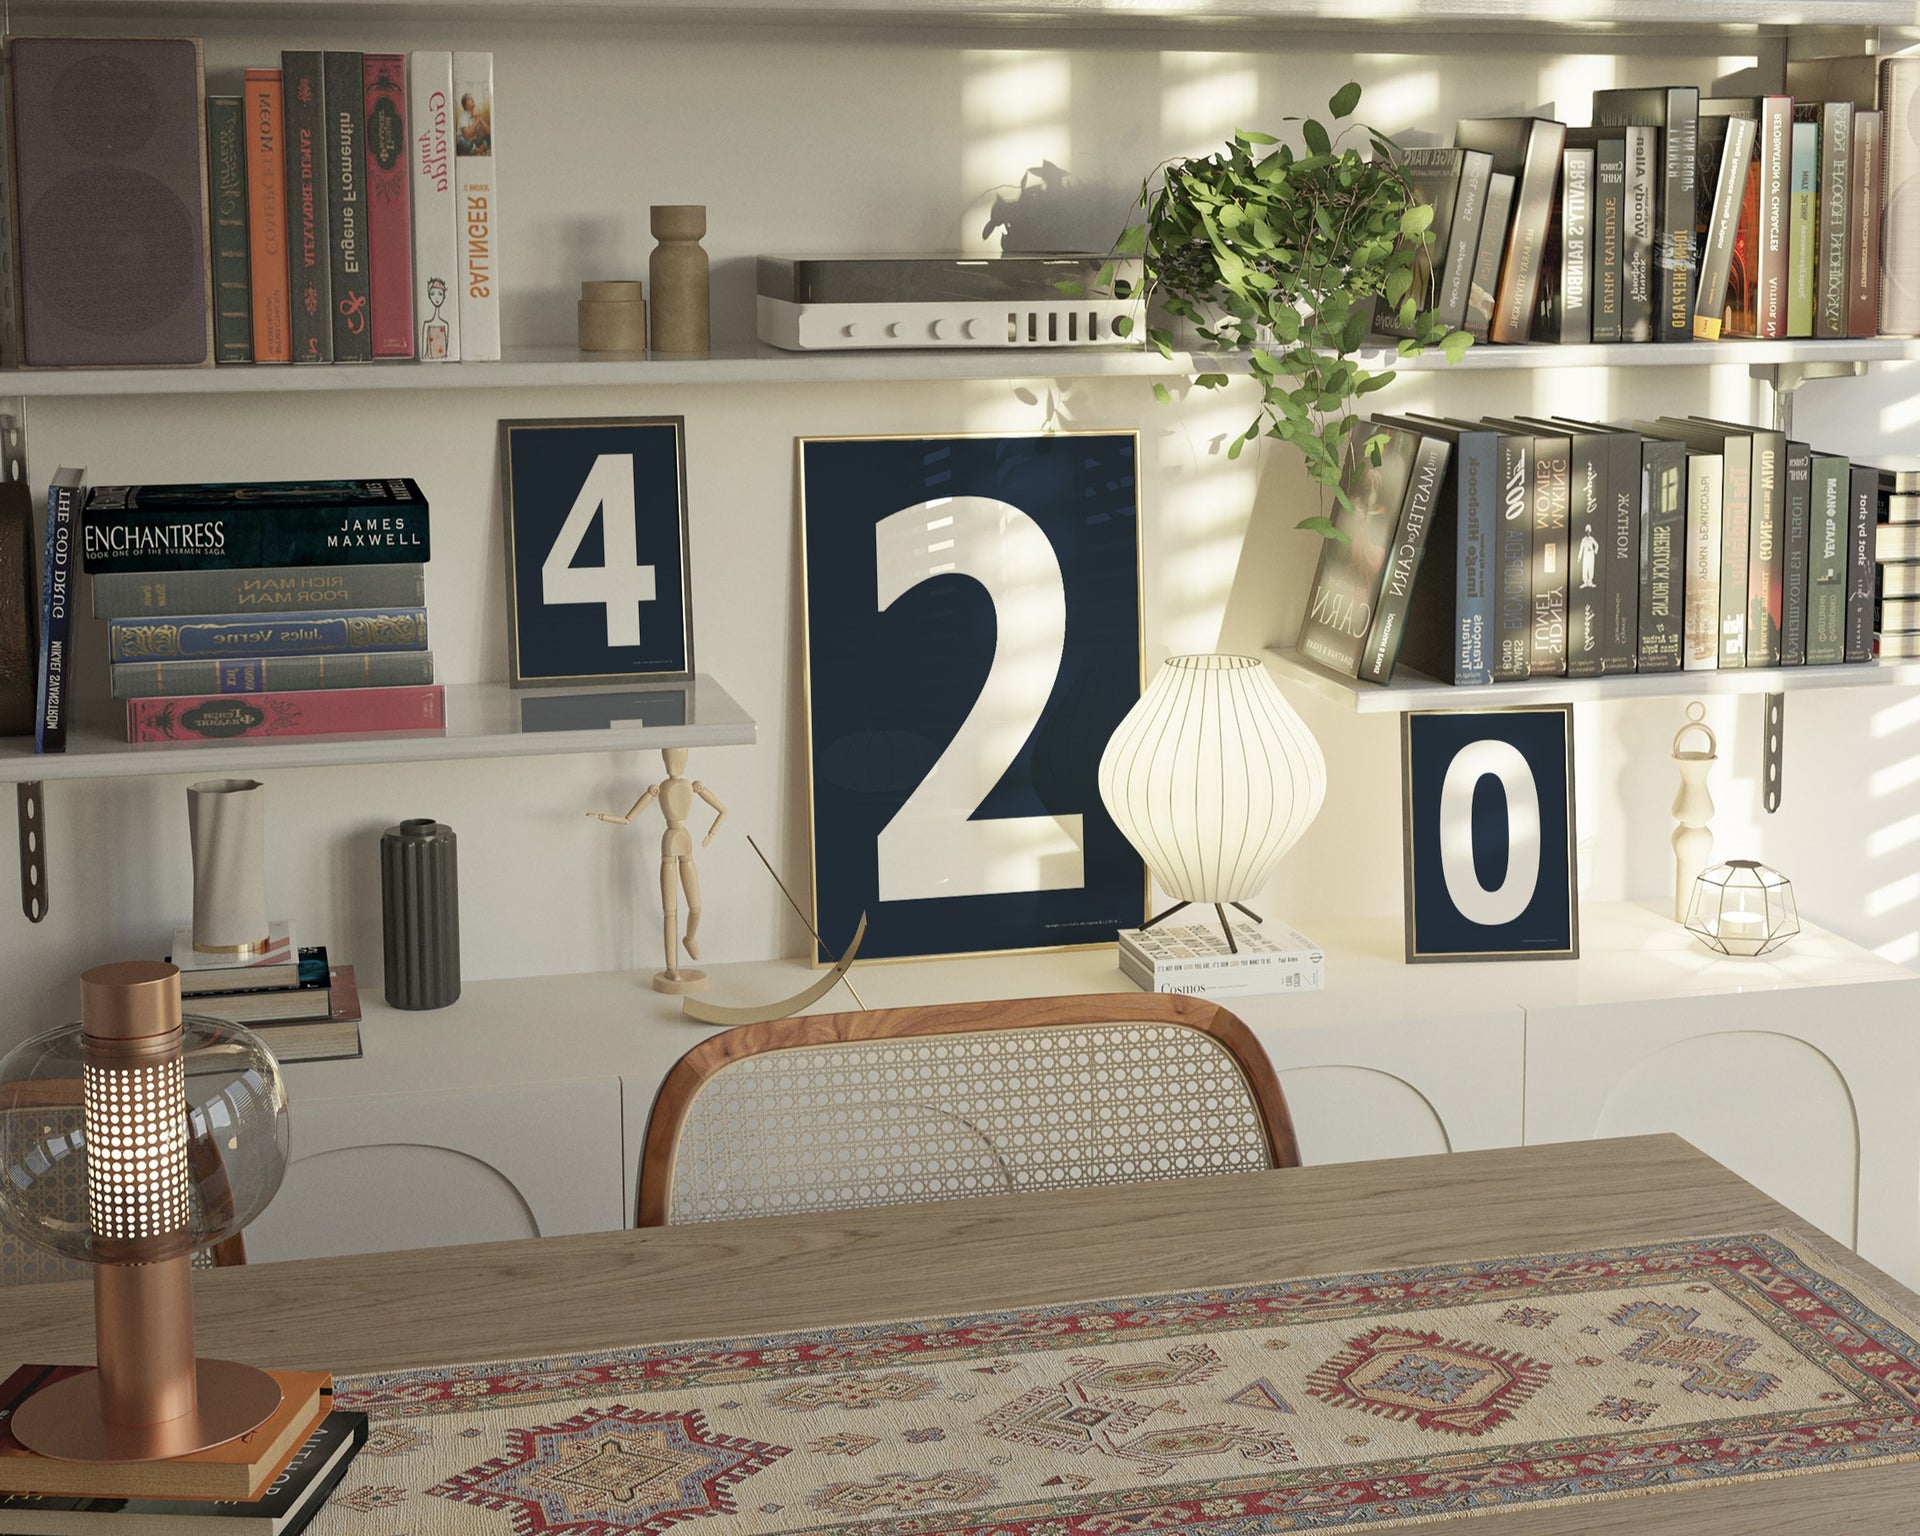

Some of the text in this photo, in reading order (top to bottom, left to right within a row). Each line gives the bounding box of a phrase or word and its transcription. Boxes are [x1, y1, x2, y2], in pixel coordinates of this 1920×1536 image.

[85, 520, 225, 552] ENCHANTRESS
[340, 518, 405, 532] JAMES
[165, 547, 201, 555] EVERMEN
[204, 547, 226, 555] SAGA
[327, 533, 421, 548] MAXWELL
[542, 453, 656, 648] 4
[875, 495, 1085, 902] 2
[1440, 739, 1541, 926] 0
[1161, 983, 1206, 994] Cosmos
